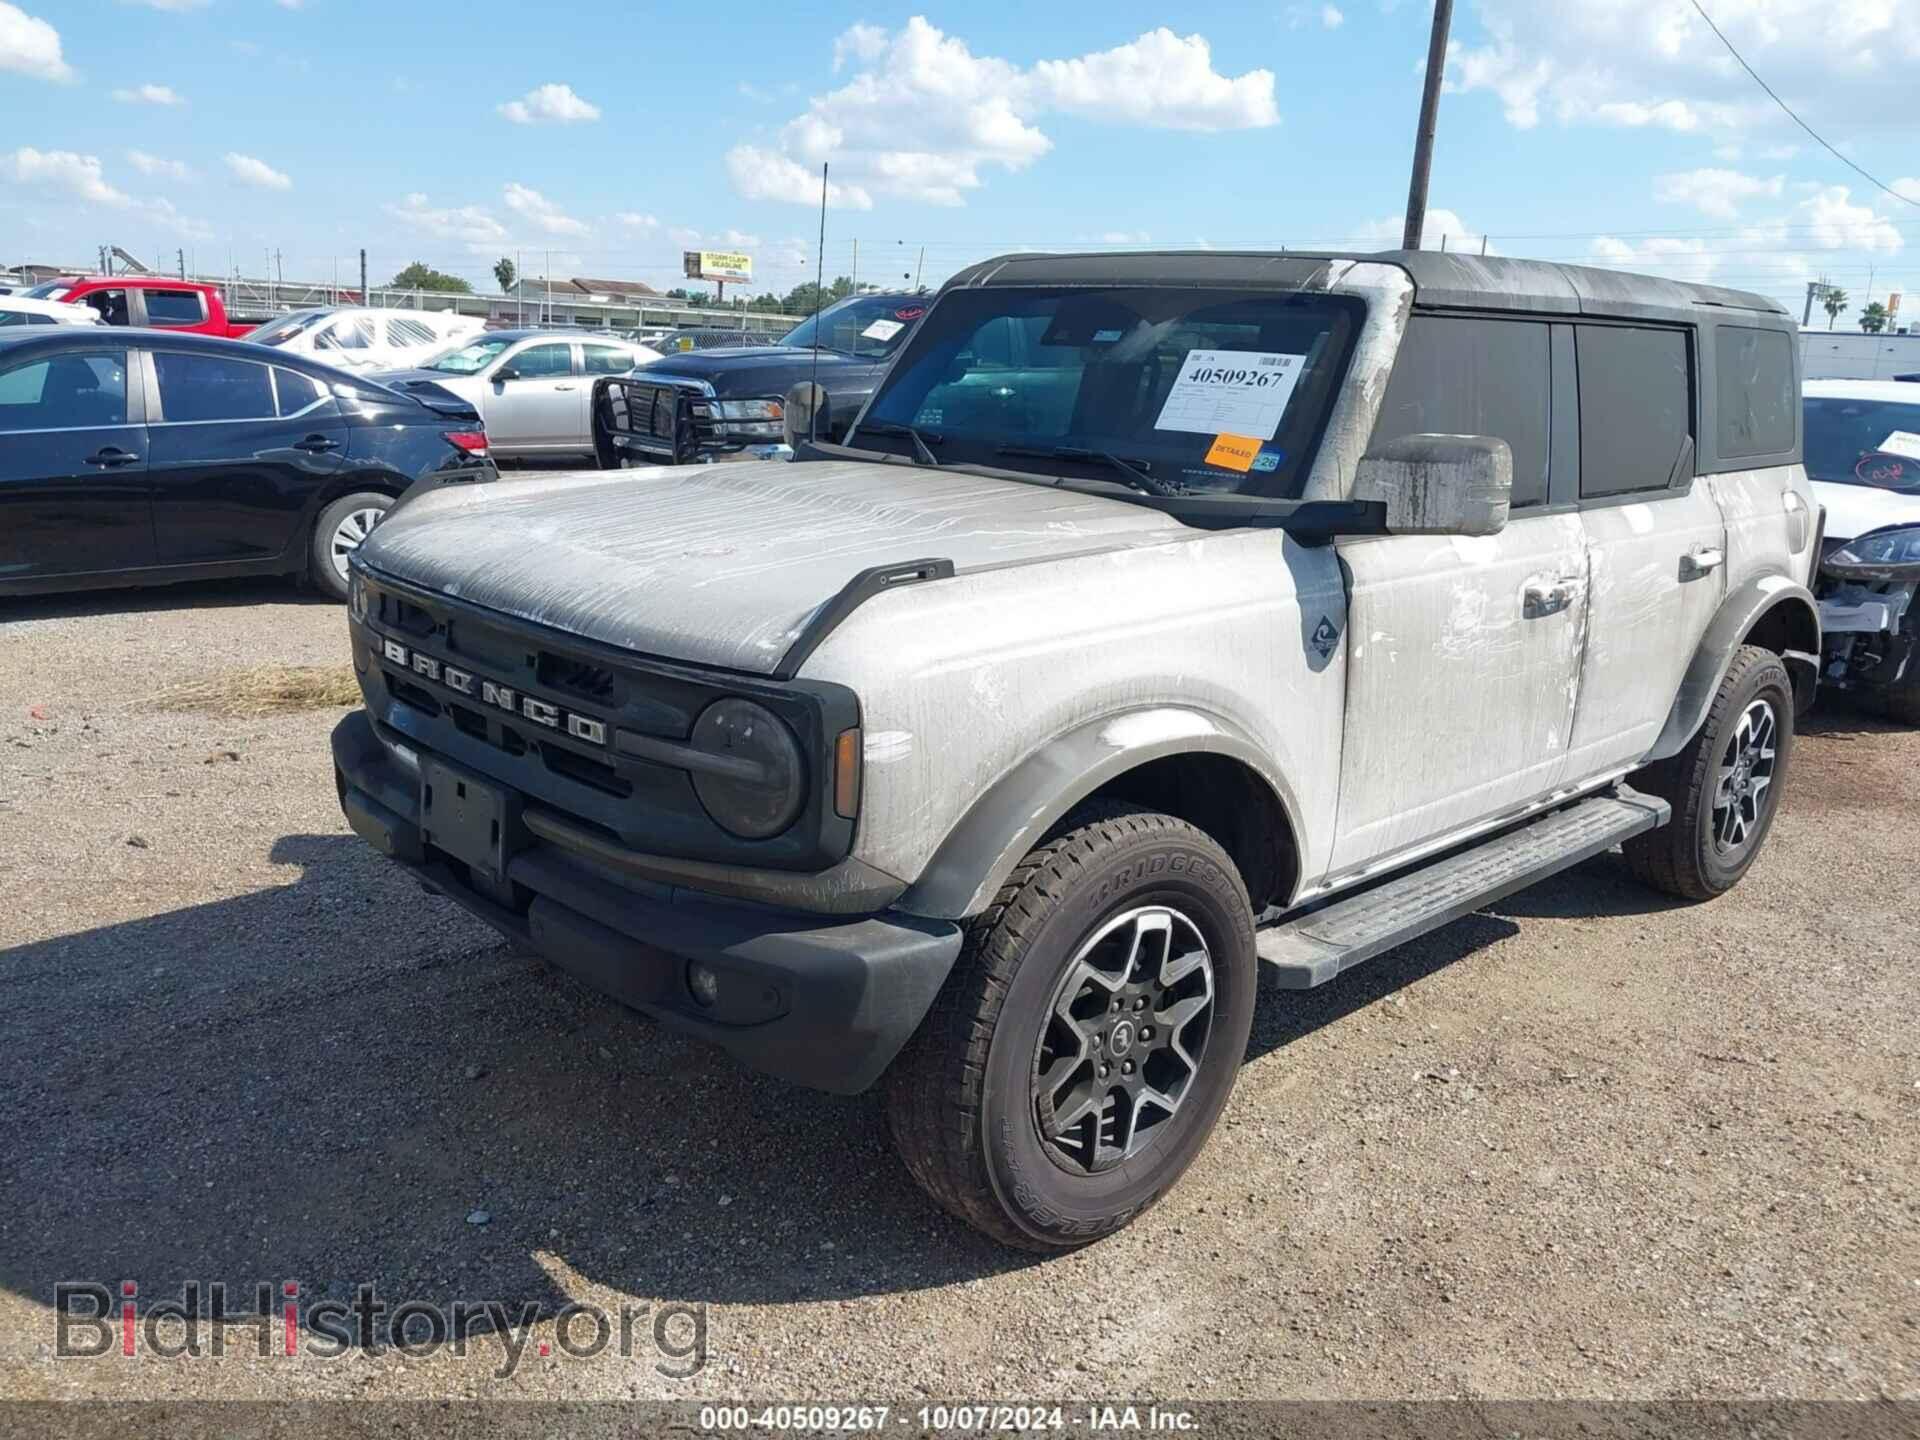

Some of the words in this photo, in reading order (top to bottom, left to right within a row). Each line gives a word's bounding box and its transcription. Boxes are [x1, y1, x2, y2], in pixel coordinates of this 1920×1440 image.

[1189, 367, 1284, 388] 40509267
[1215, 444, 1252, 458] DETAILED
[384, 639, 606, 745] BRONCO
